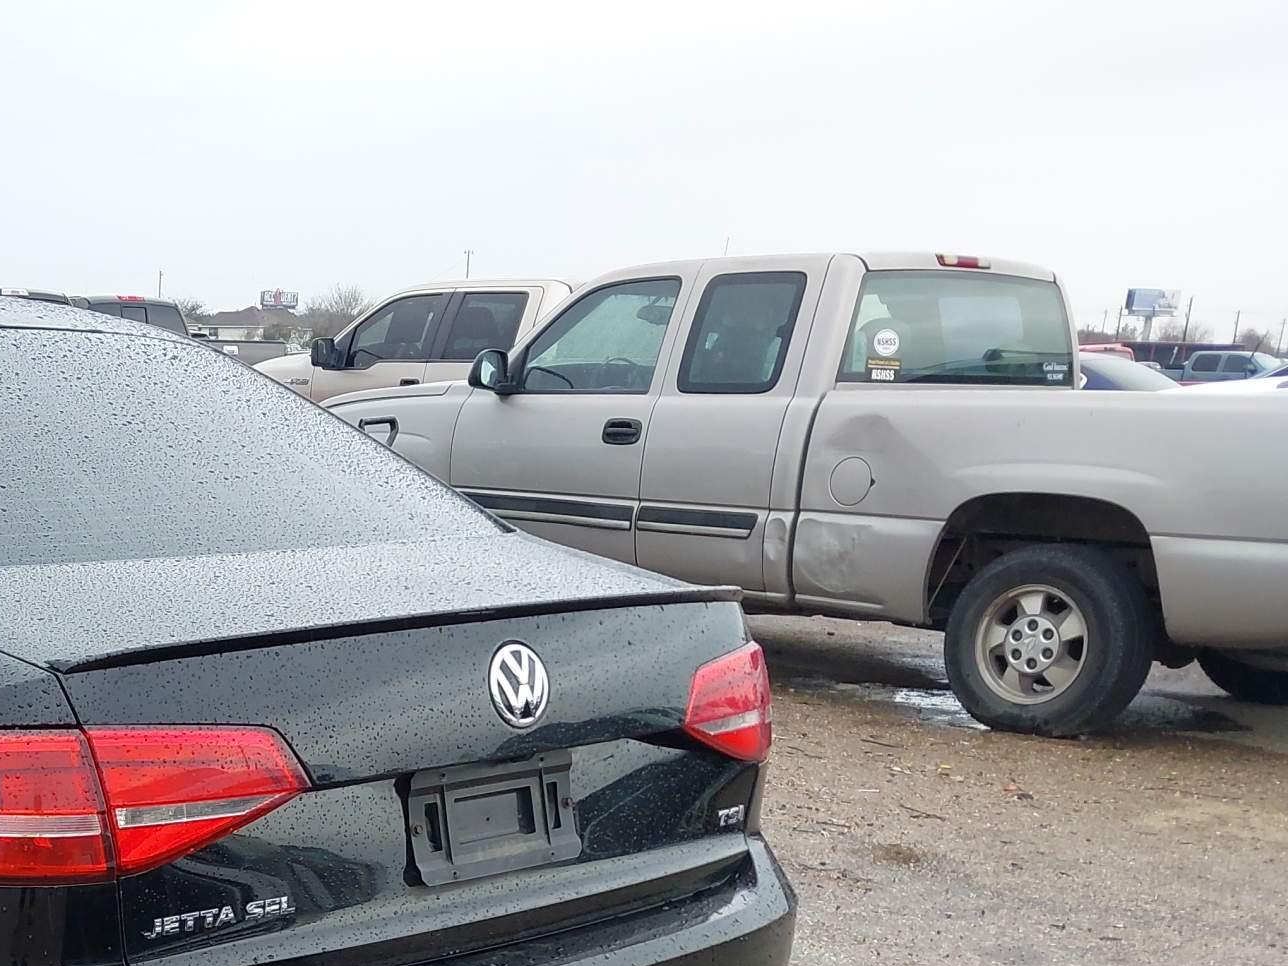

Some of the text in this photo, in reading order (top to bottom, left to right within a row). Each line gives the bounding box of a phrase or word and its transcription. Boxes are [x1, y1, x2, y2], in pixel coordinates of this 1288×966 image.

[718, 804, 745, 827] TSI
[140, 895, 296, 940] JETTA SEL
